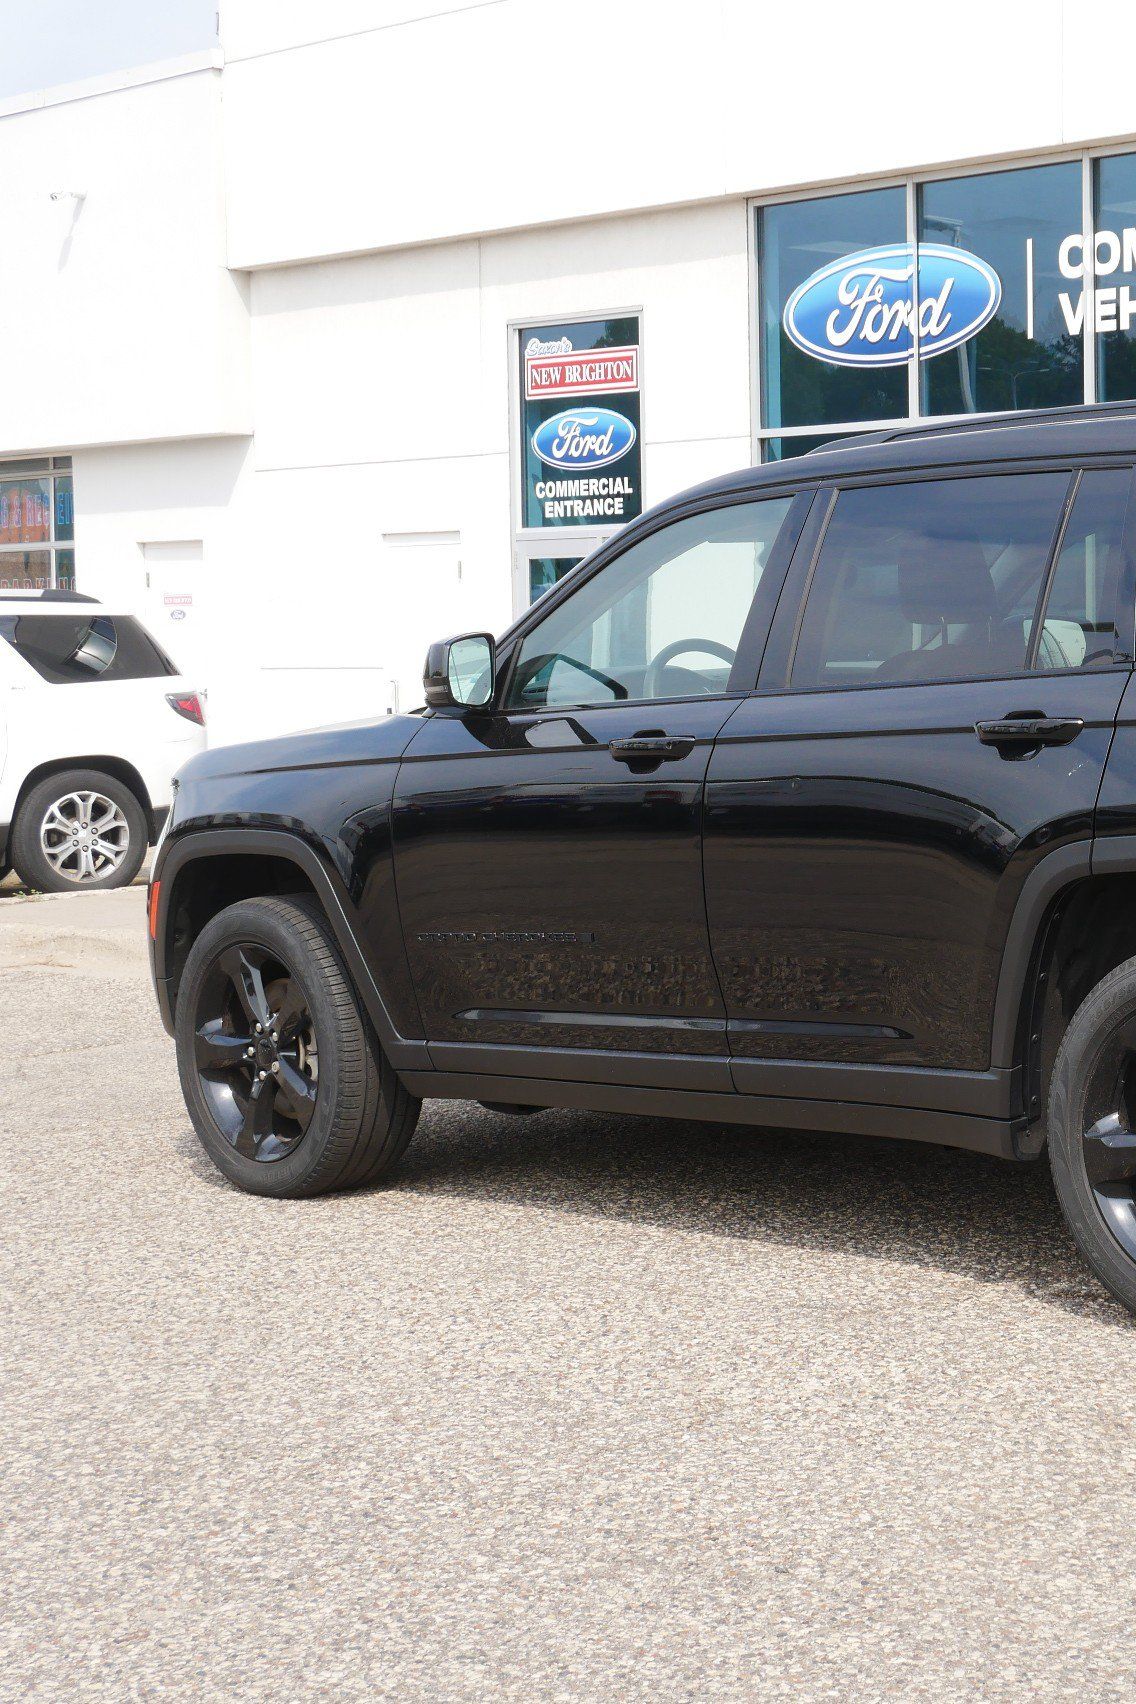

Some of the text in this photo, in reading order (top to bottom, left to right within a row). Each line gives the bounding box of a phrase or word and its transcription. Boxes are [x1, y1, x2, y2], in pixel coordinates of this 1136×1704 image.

[826, 264, 955, 347] Ford
[531, 359, 633, 388] NEW BRIGHTON
[552, 416, 614, 458] Ford
[534, 476, 633, 500] COMMERCIAL
[544, 497, 625, 519] ENTRANCE
